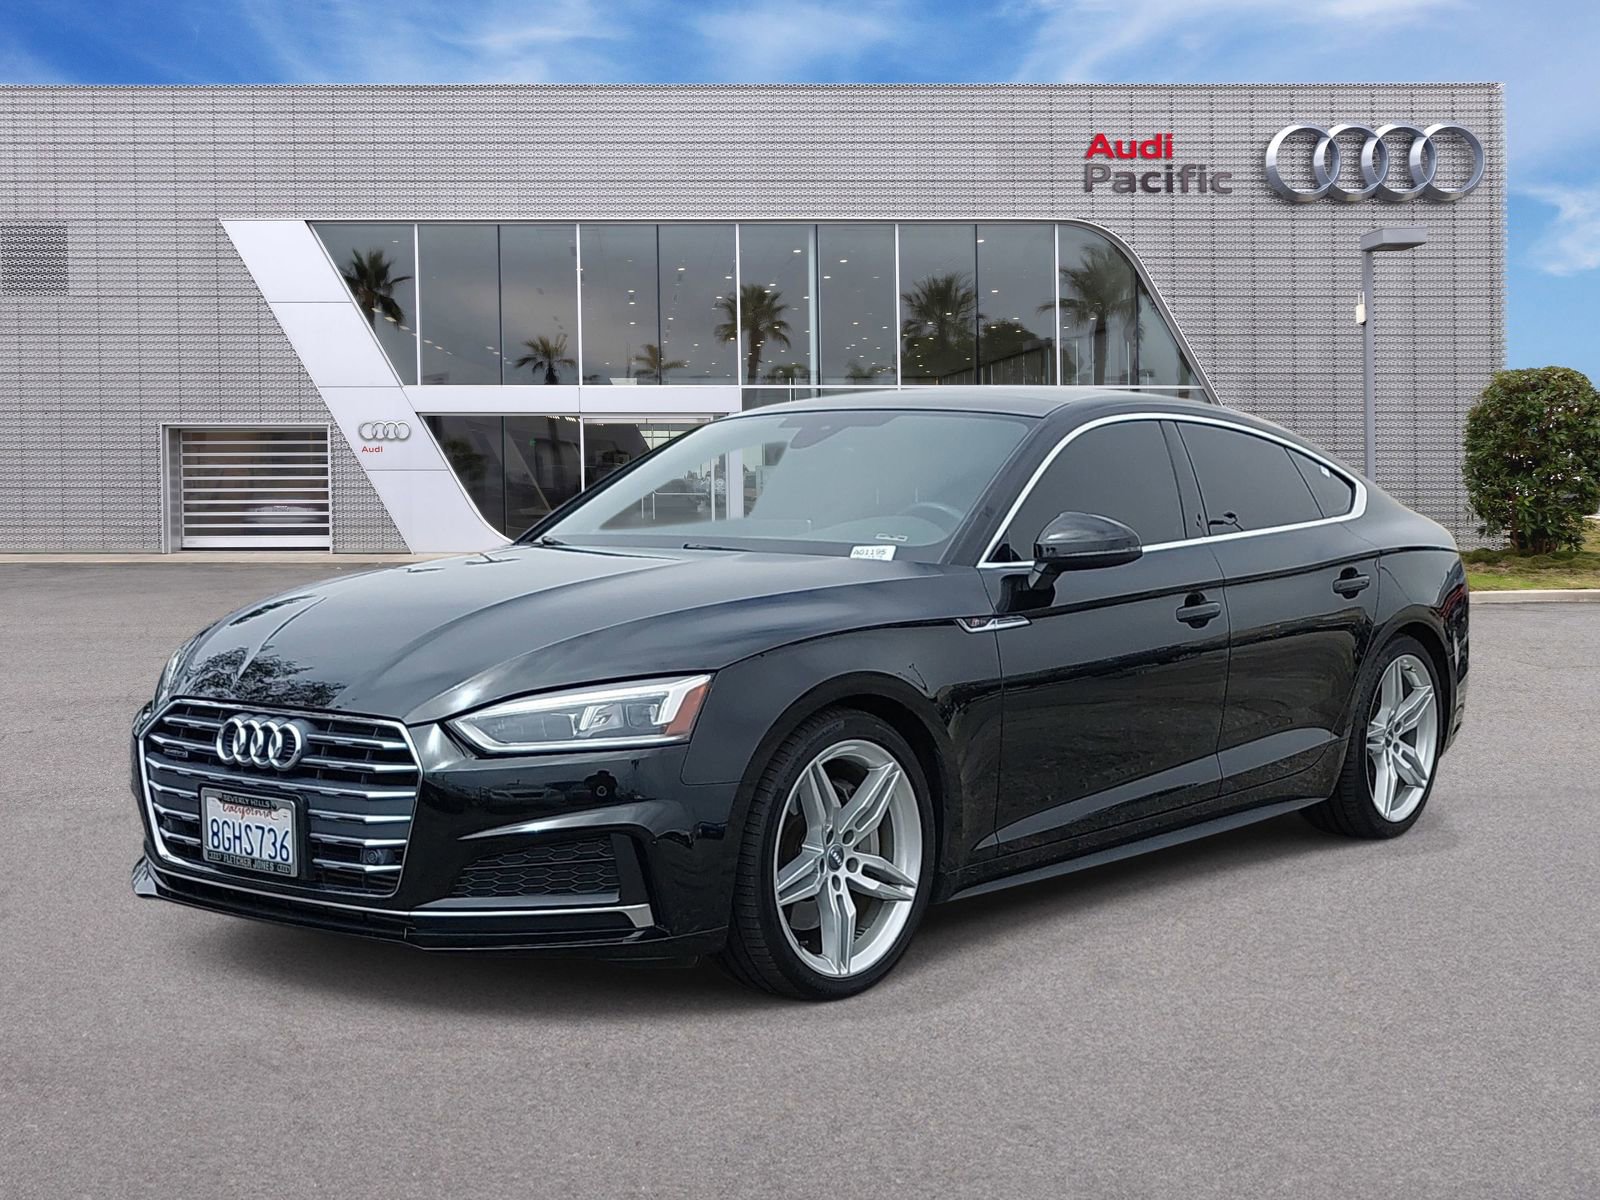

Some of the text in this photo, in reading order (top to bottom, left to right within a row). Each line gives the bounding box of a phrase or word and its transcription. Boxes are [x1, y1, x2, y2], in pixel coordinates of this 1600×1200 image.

[1085, 132, 1173, 160] Audi
[1084, 163, 1233, 194] Pacific
[361, 445, 384, 453] Audi
[223, 794, 270, 808] BEVERLY HILLS
[210, 818, 290, 862] 8GHS736
[223, 853, 275, 872] FLETCHER JONES
